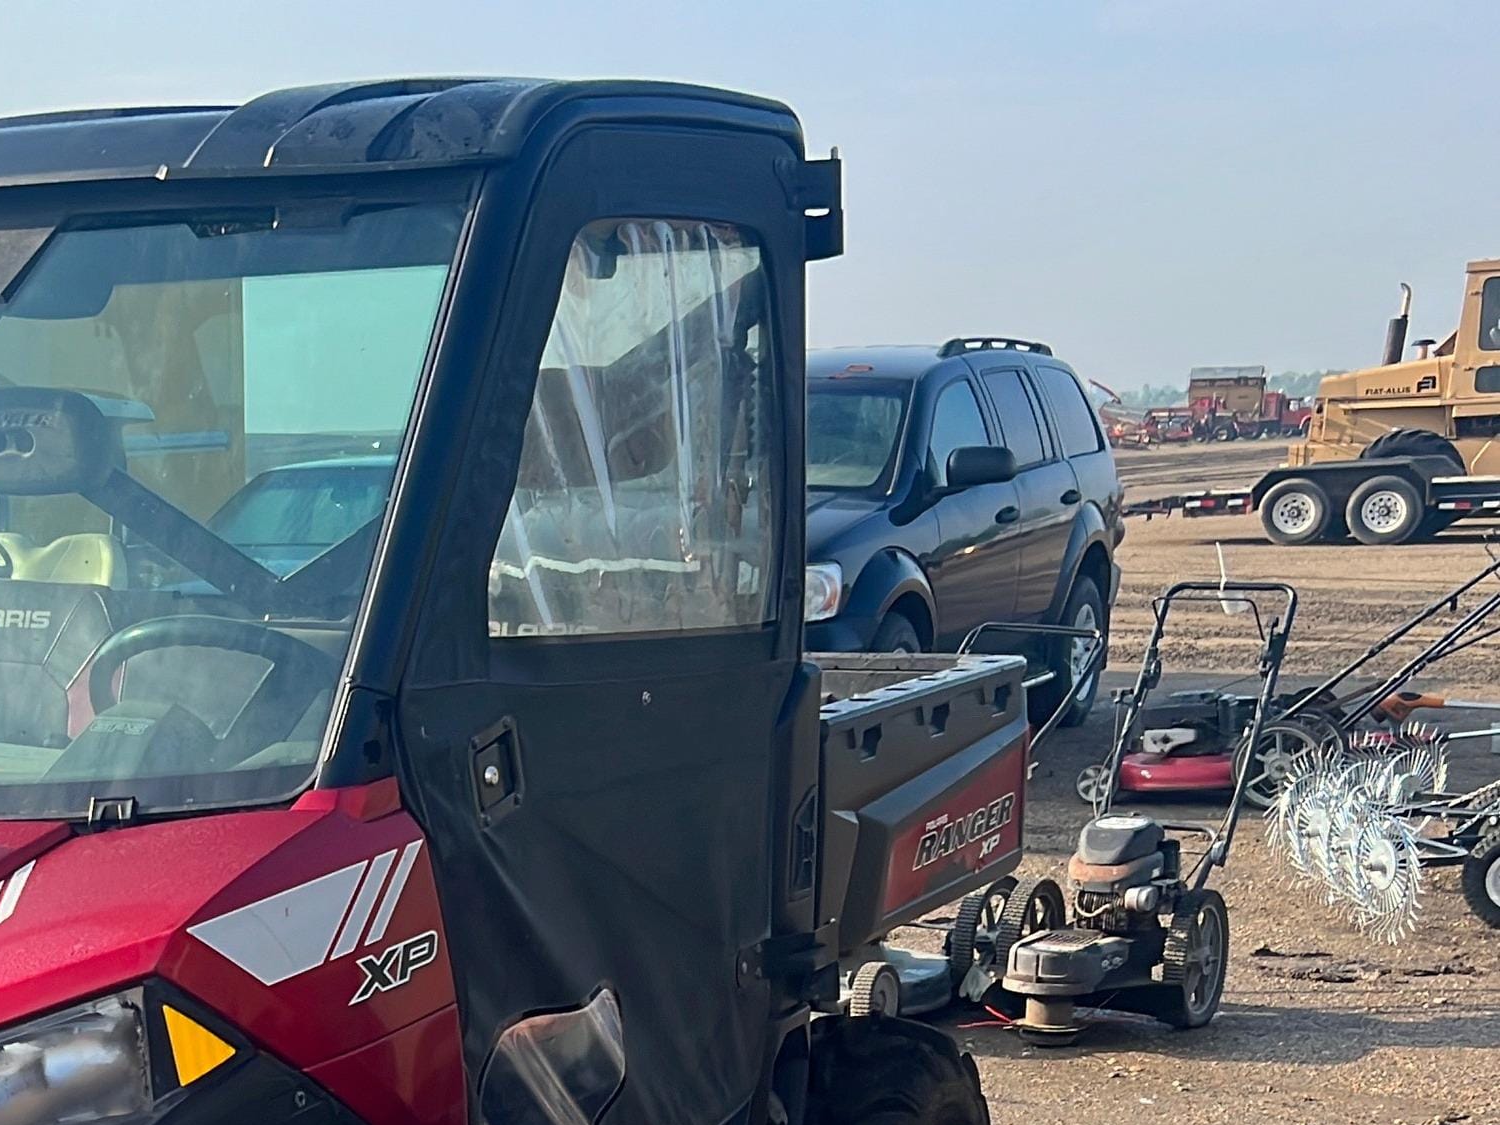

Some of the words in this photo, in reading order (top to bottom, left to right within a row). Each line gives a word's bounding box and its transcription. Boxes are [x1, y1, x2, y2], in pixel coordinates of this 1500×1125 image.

[912, 792, 1016, 871] RANGER
[979, 833, 1001, 859] XP
[348, 930, 438, 1006] XP
